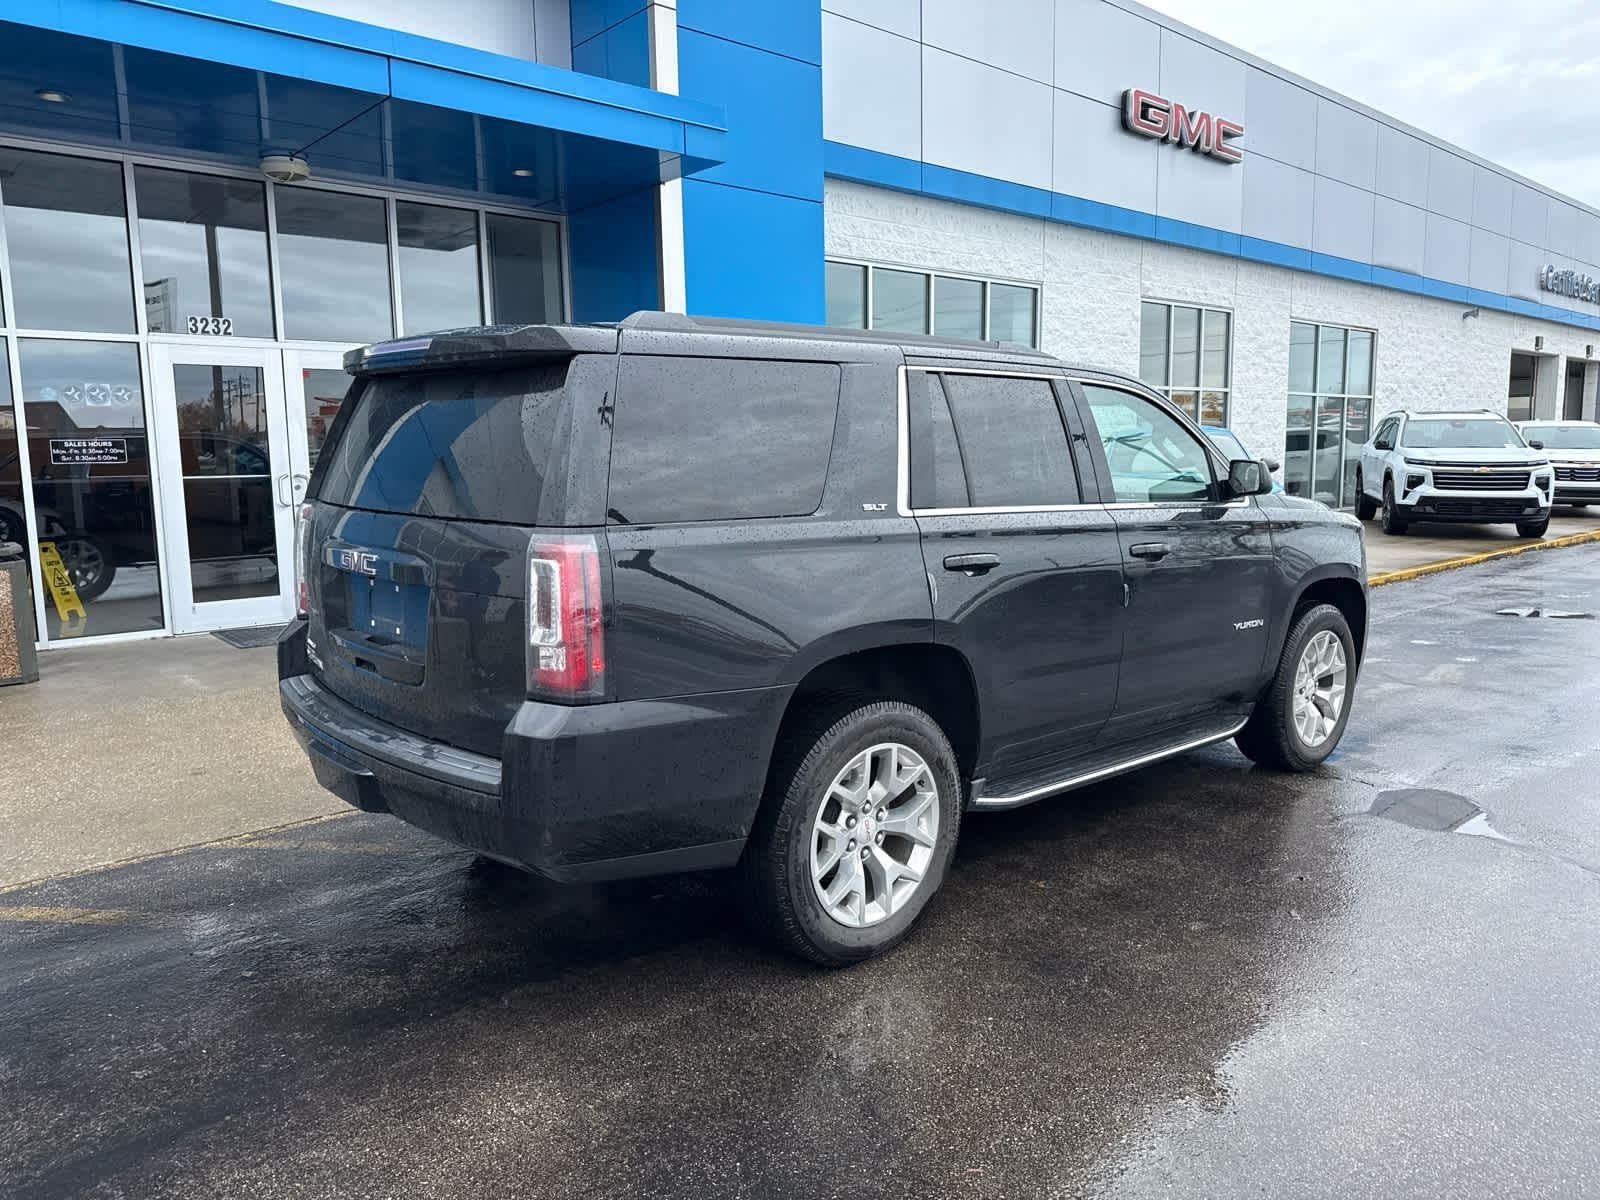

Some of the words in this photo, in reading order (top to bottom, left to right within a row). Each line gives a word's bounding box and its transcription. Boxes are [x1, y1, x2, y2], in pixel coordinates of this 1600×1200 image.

[1122, 87, 1245, 162] GMC
[188, 316, 232, 336] 3232
[862, 503, 889, 511] SLT
[340, 551, 380, 576] GMC
[1233, 618, 1264, 631] YUKON
